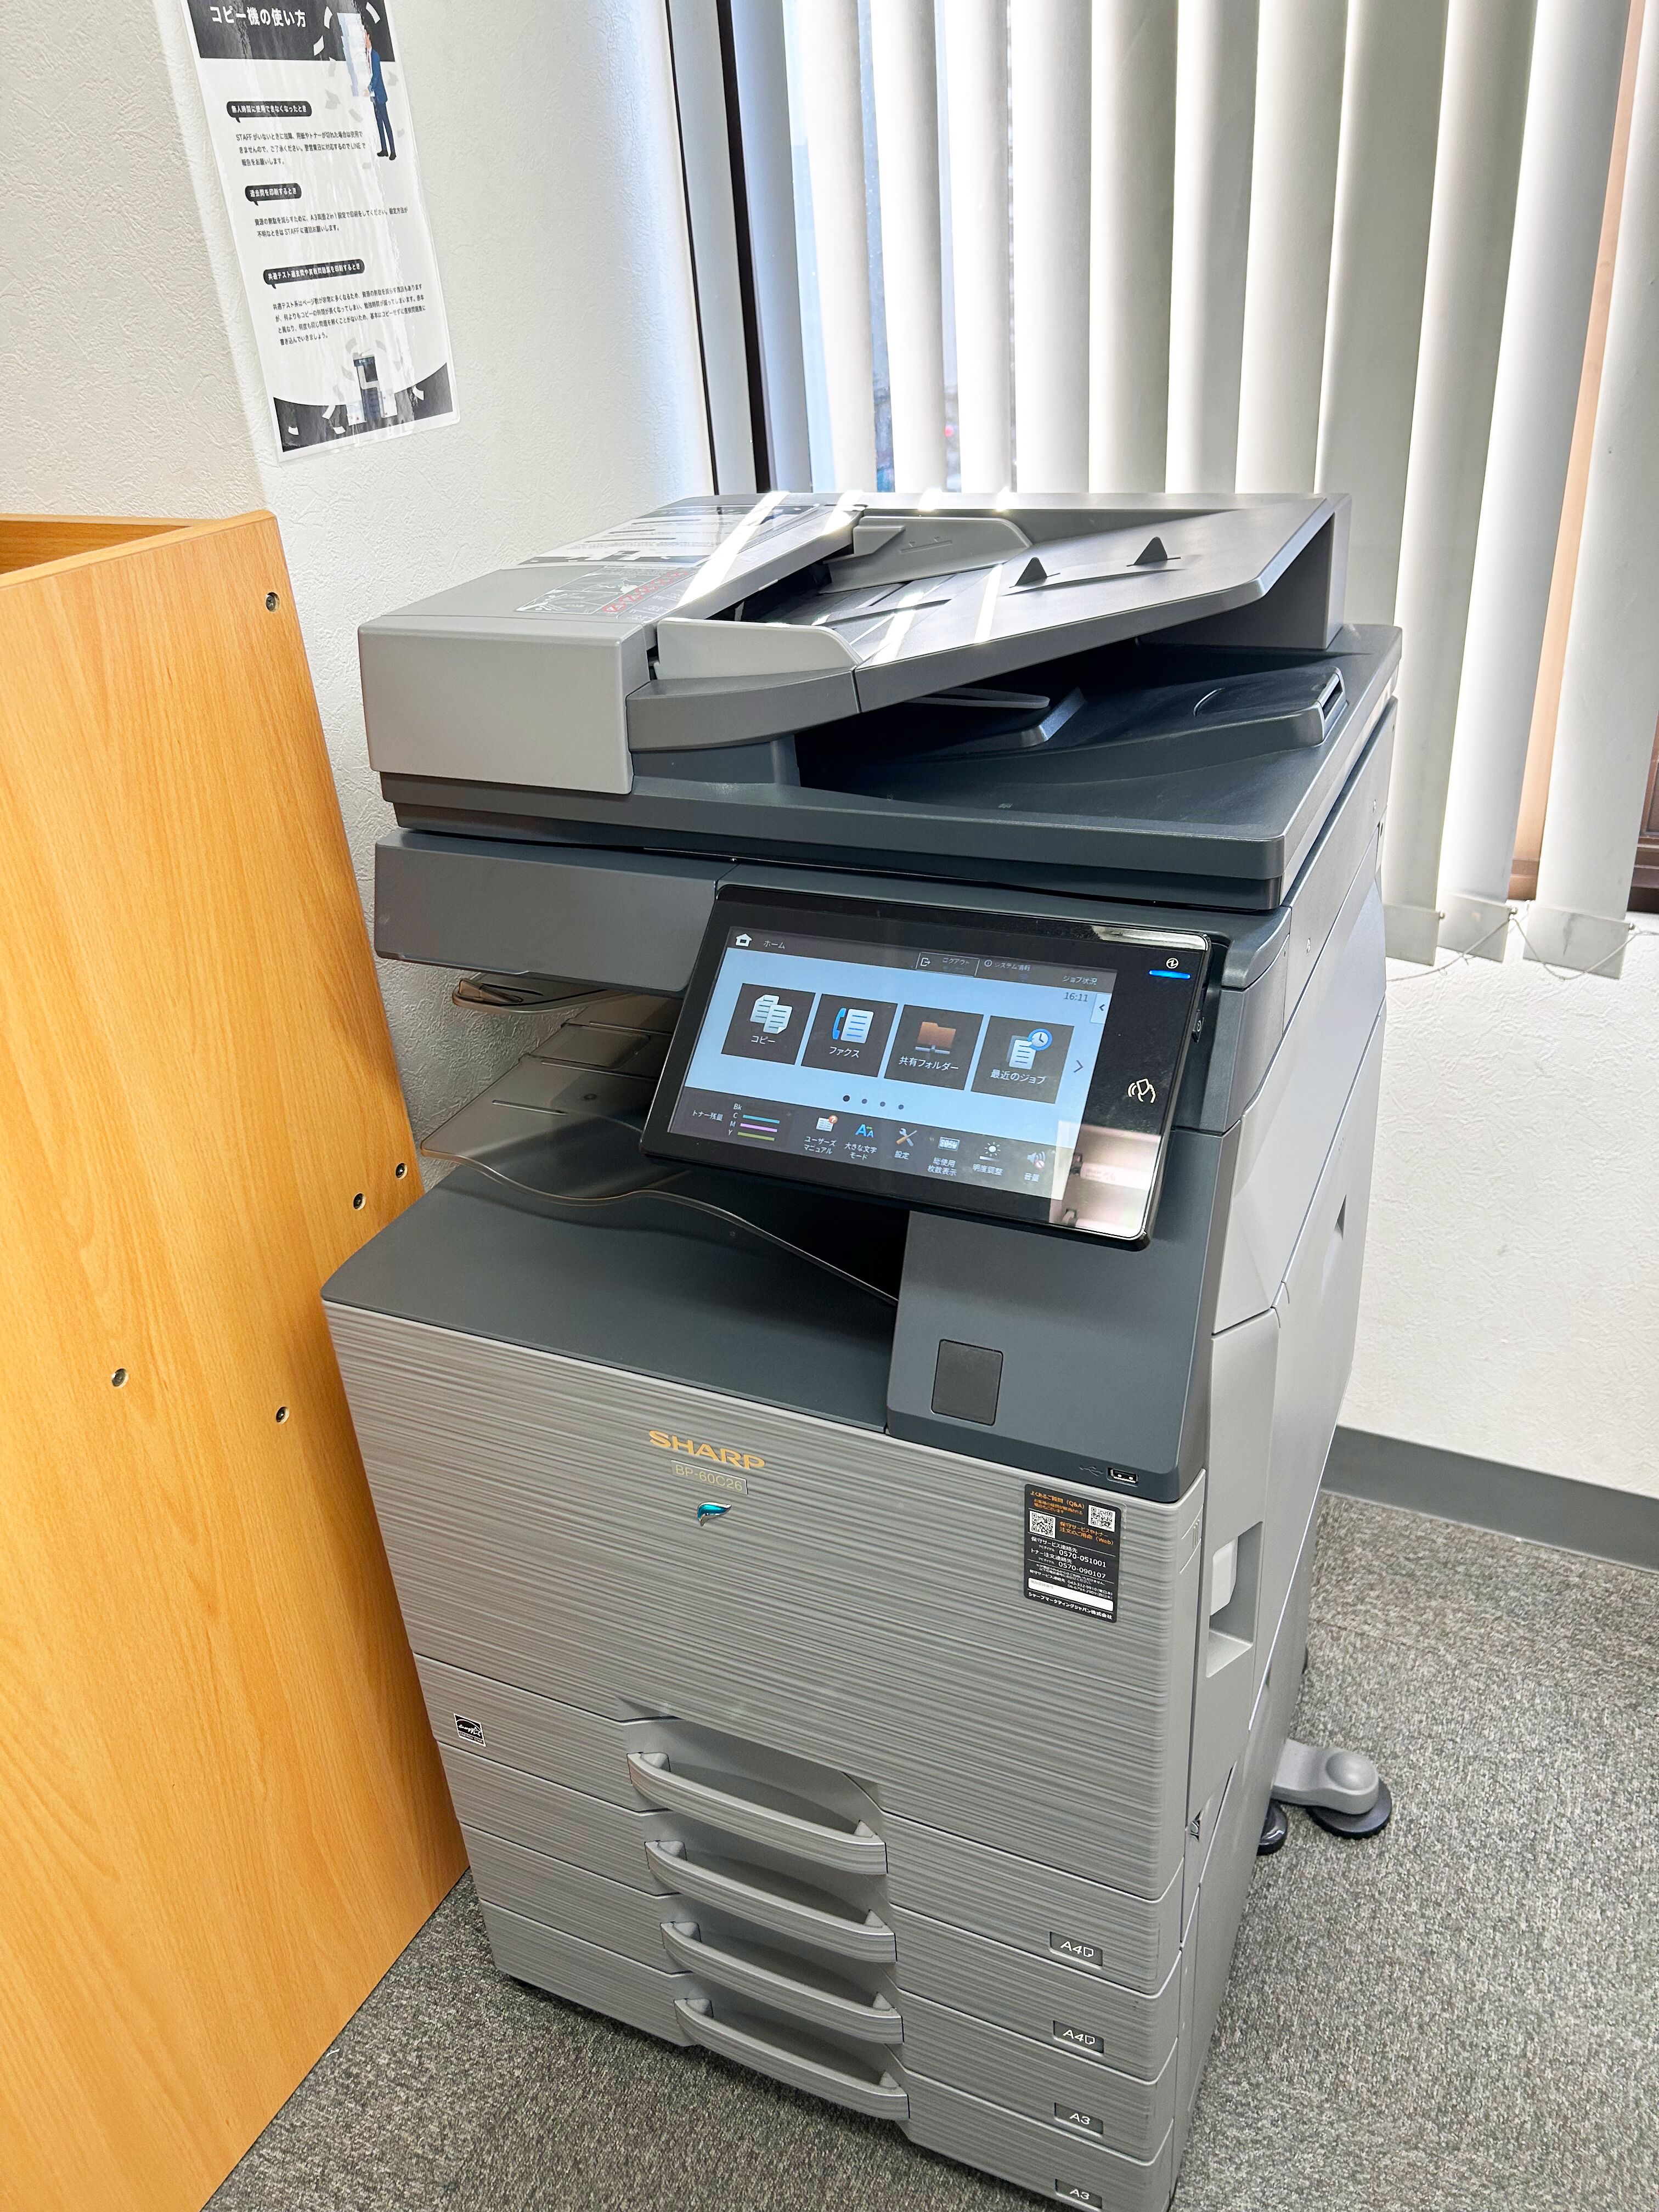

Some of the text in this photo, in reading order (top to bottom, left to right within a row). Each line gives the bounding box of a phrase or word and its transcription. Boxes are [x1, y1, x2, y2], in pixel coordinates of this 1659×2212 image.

[210, 5, 306, 27] コピー機の使い方
[763, 940, 785, 949] ホーム
[1062, 975, 1097, 986] ジョブ状況
[1064, 992, 1088, 1002] 16:11
[751, 1035, 775, 1045] コピー
[830, 1046, 860, 1058] ファクス
[899, 1056, 959, 1071] 共有フォルダー
[990, 1069, 1045, 1085] 最近のジョブ
[692, 1110, 723, 1121] トナー残量
[804, 1136, 837, 1147] ユーザーズ
[844, 1142, 878, 1153] 大きな文字
[804, 1144, 832, 1154] マニュアル
[894, 1150, 911, 1160] 設定
[850, 1152, 868, 1160] モード
[649, 1430, 766, 1470] SHARP
[675, 1464, 742, 1492] BP-60C26
[1059, 1550, 1107, 1568] 0570-051001
[1058, 1561, 1106, 1579] 0570-090107
[1060, 1940, 1082, 1955] A4
[1063, 2028, 1084, 2042] A4
[1069, 2112, 1091, 2125] A3
[1069, 2188, 1090, 2201] A3
